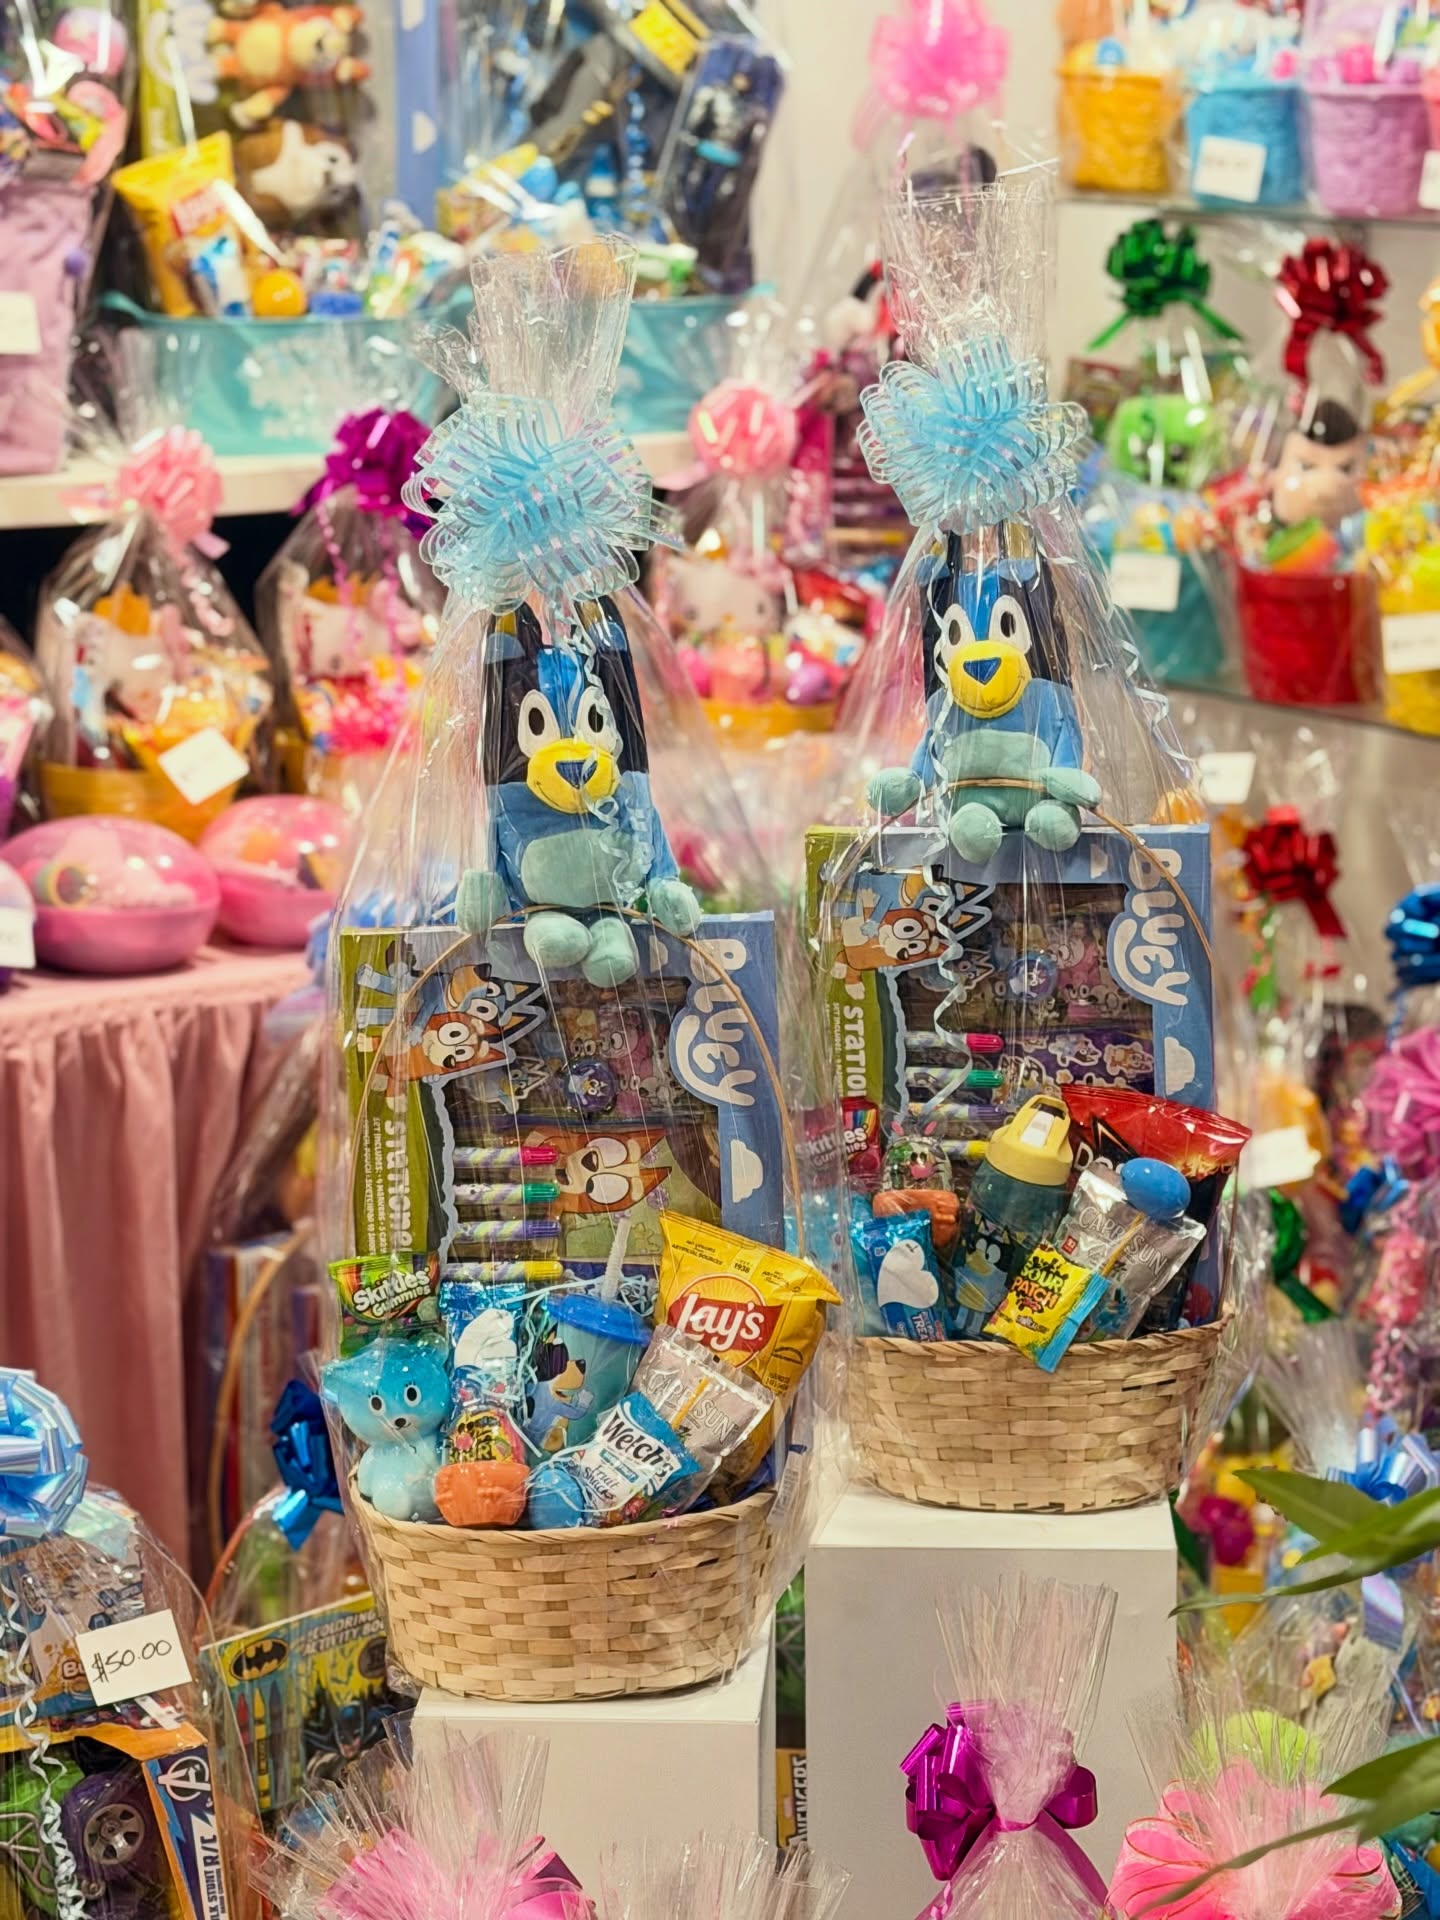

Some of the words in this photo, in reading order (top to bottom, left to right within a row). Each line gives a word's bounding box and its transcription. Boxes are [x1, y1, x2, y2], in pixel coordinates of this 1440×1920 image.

[733, 1262, 751, 1274] 1938
[1125, 1233, 1168, 1276] SUN
[1011, 1275, 1060, 1309] PATCH
[1020, 1263, 1065, 1294] SOUR
[676, 1292, 766, 1352] Lay's
[693, 1398, 734, 1446] SUN
[92, 1640, 173, 1684] $50.00
[200, 1834, 220, 1867] R/C
[204, 1871, 218, 1902] STUNT
